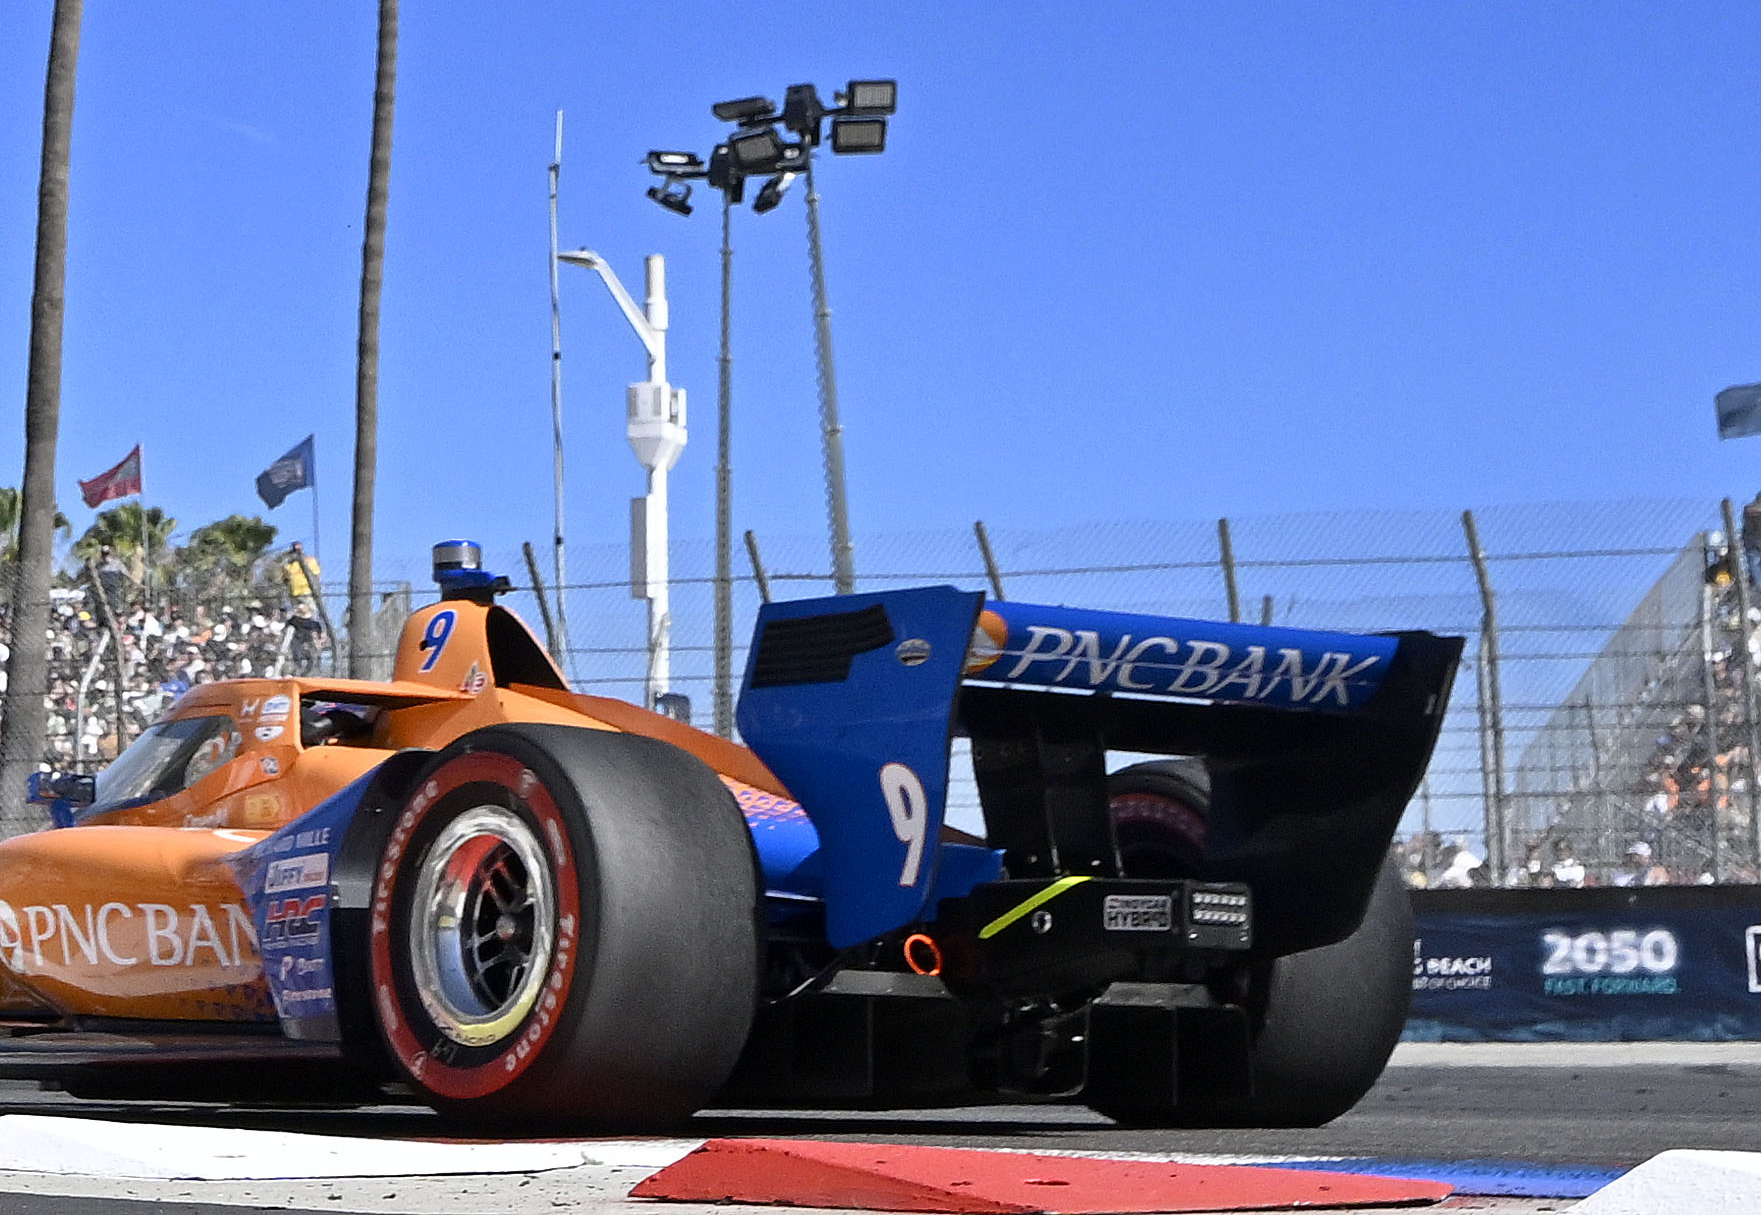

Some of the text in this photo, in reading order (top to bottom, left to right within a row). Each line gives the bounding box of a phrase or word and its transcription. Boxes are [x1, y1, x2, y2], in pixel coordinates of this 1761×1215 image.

[416, 609, 457, 674] 9
[878, 762, 928, 888] 9
[22, 901, 262, 969] PNCBAN
[1542, 929, 1678, 974] 2050
